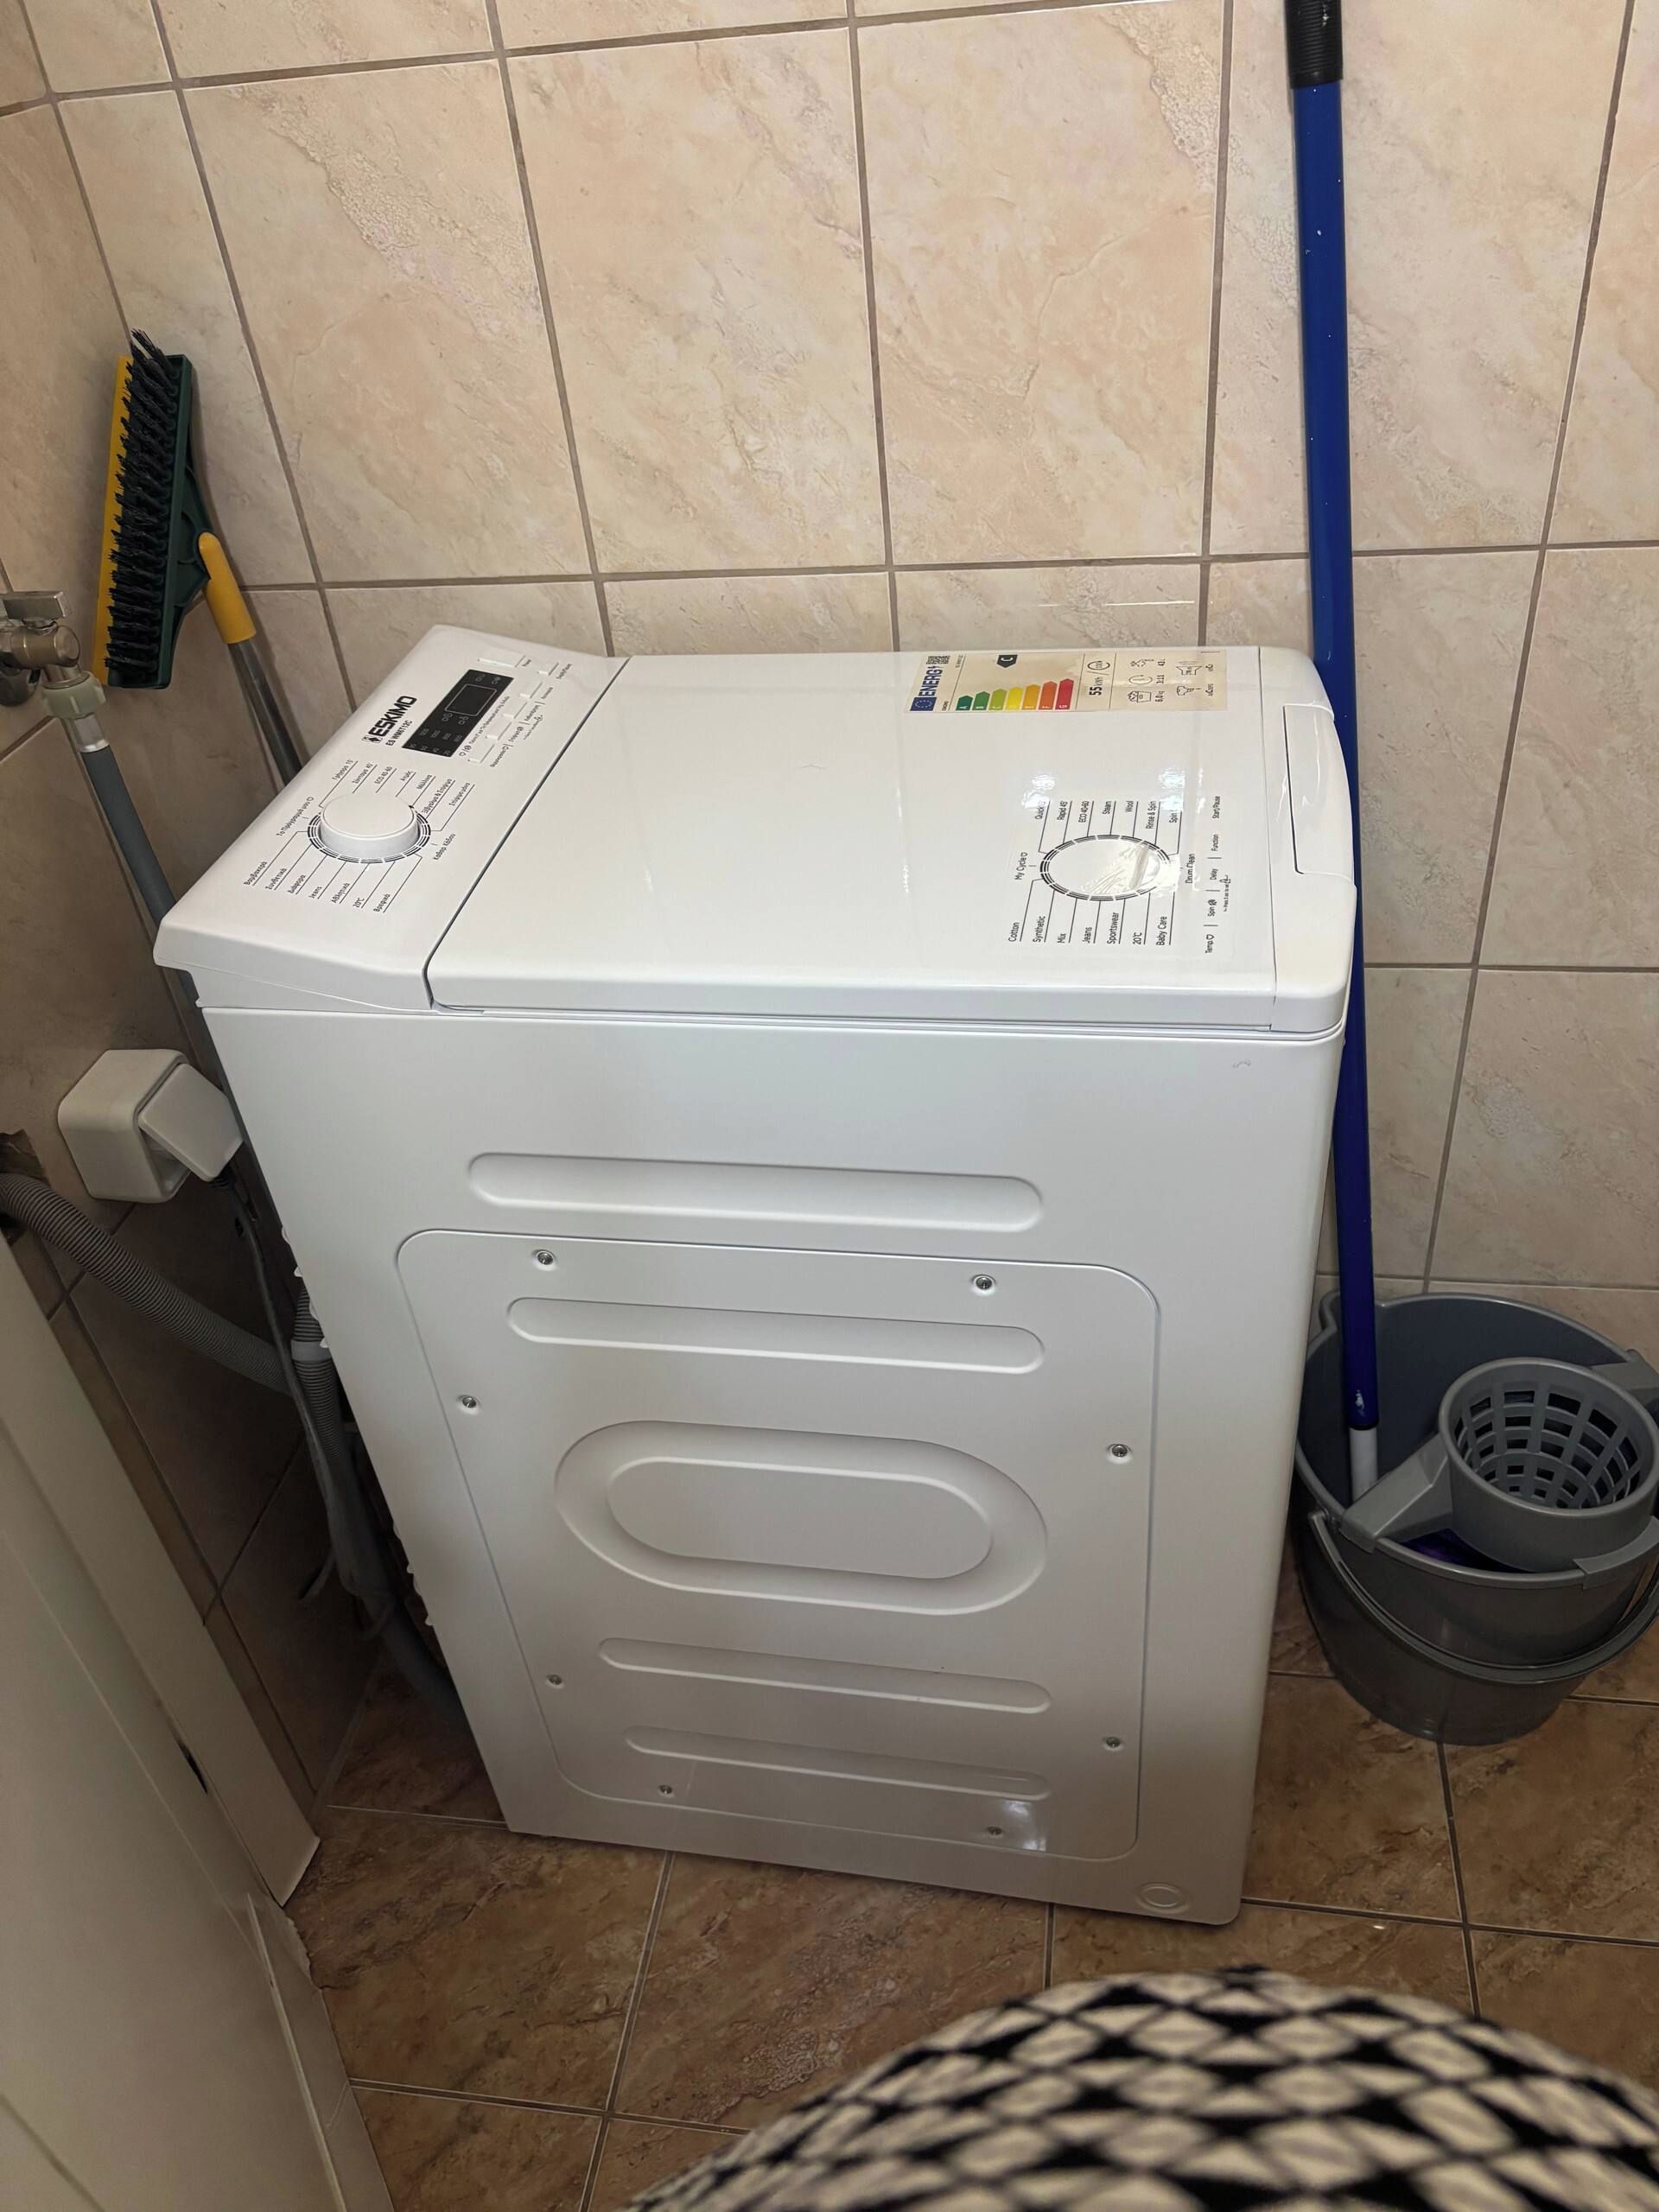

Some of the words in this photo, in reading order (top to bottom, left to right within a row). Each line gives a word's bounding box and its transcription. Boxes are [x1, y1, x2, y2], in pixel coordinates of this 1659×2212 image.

[1089, 687, 1103, 696] 55
[368, 696, 416, 736] ESKIMO
[1080, 800, 1090, 814] 40-60
[1103, 801, 1111, 815] Steam
[1125, 800, 1134, 812] Wool
[1147, 801, 1156, 811] Spin
[1058, 807, 1067, 820] Rapid
[1078, 813, 1087, 823] ECO
[1146, 816, 1154, 829] Rinse
[1016, 857, 1027, 871] Cycle
[1185, 869, 1194, 883] Drum
[1210, 868, 1218, 880] Delay
[309, 887, 322, 899] Jeans
[1033, 916, 1046, 943] Synthetic
[1107, 912, 1119, 944] Sportswear
[1157, 916, 1167, 930] Care
[1008, 922, 1020, 942] Cotton
[1058, 933, 1066, 944] Mix
[1082, 927, 1092, 944] Jeans
[1133, 932, 1141, 944] 20°C
[1156, 931, 1167, 945] Baby
